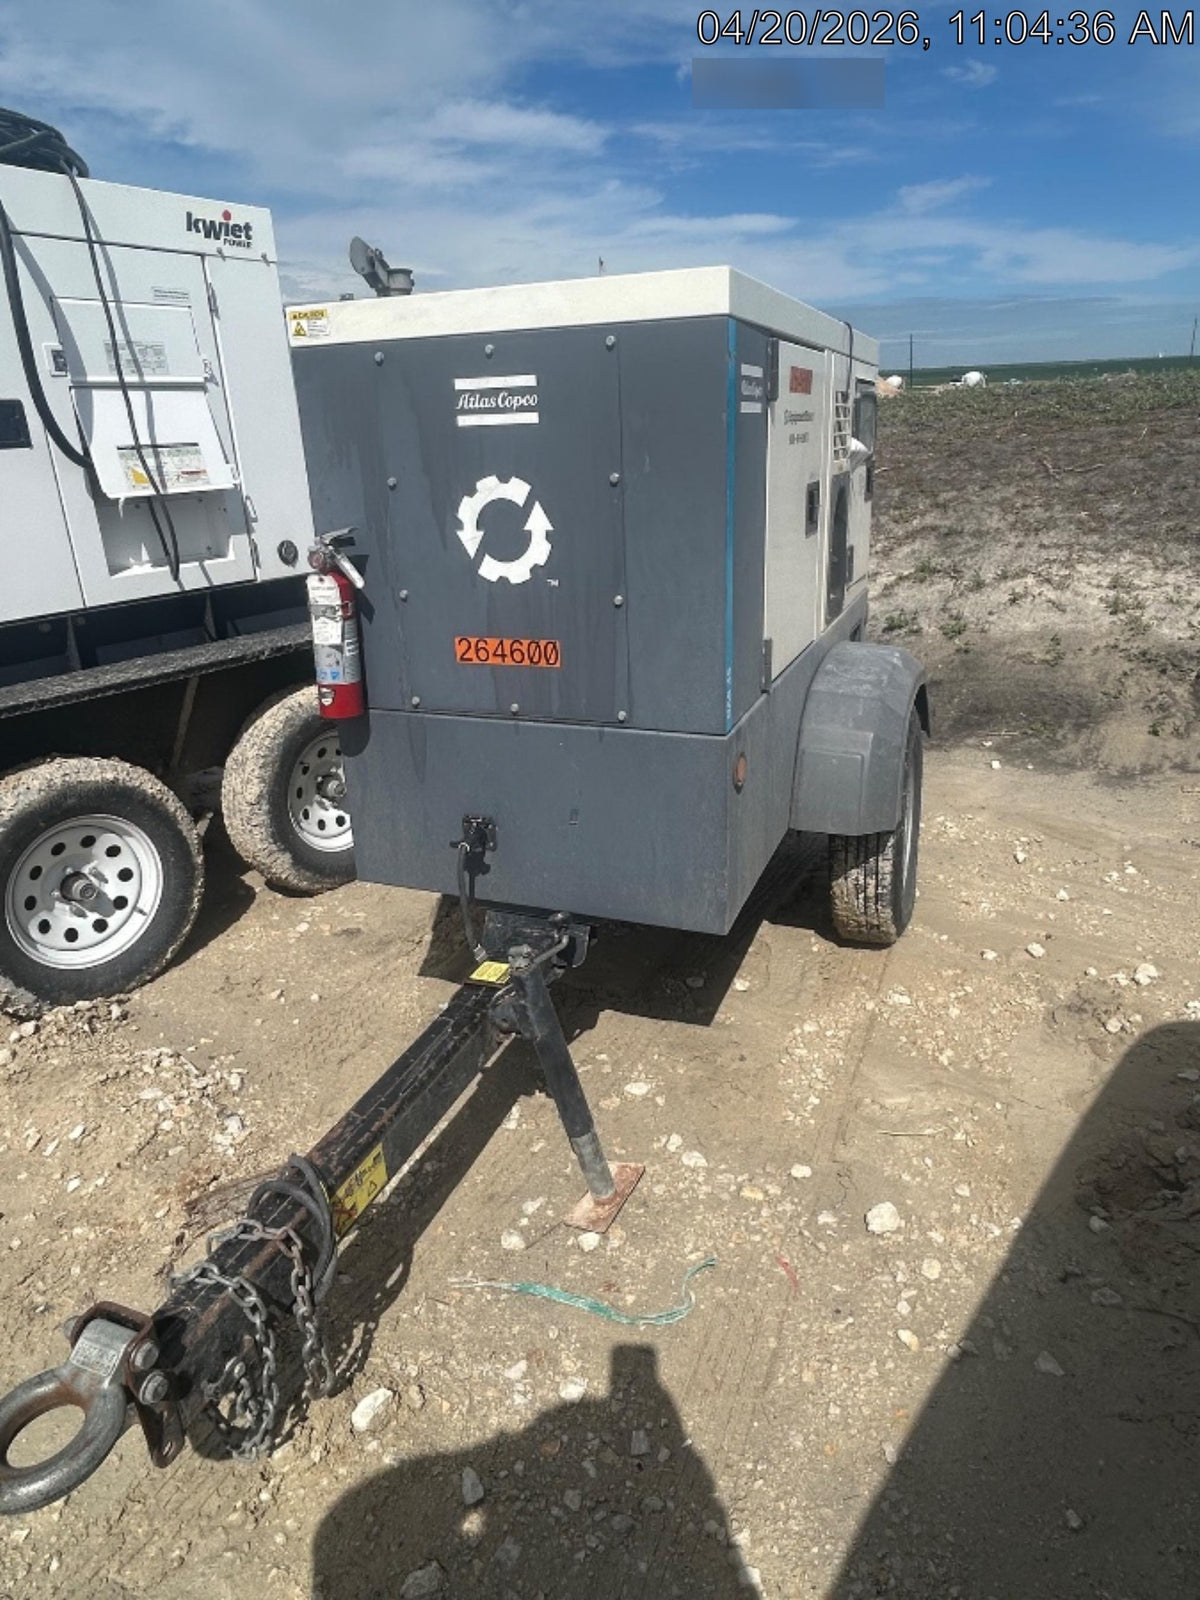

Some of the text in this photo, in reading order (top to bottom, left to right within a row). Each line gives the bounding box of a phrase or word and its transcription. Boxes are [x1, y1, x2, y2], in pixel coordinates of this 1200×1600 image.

[186, 210, 252, 241] kwiet
[456, 391, 538, 411] Atlas Copco
[458, 638, 559, 666] 264600
